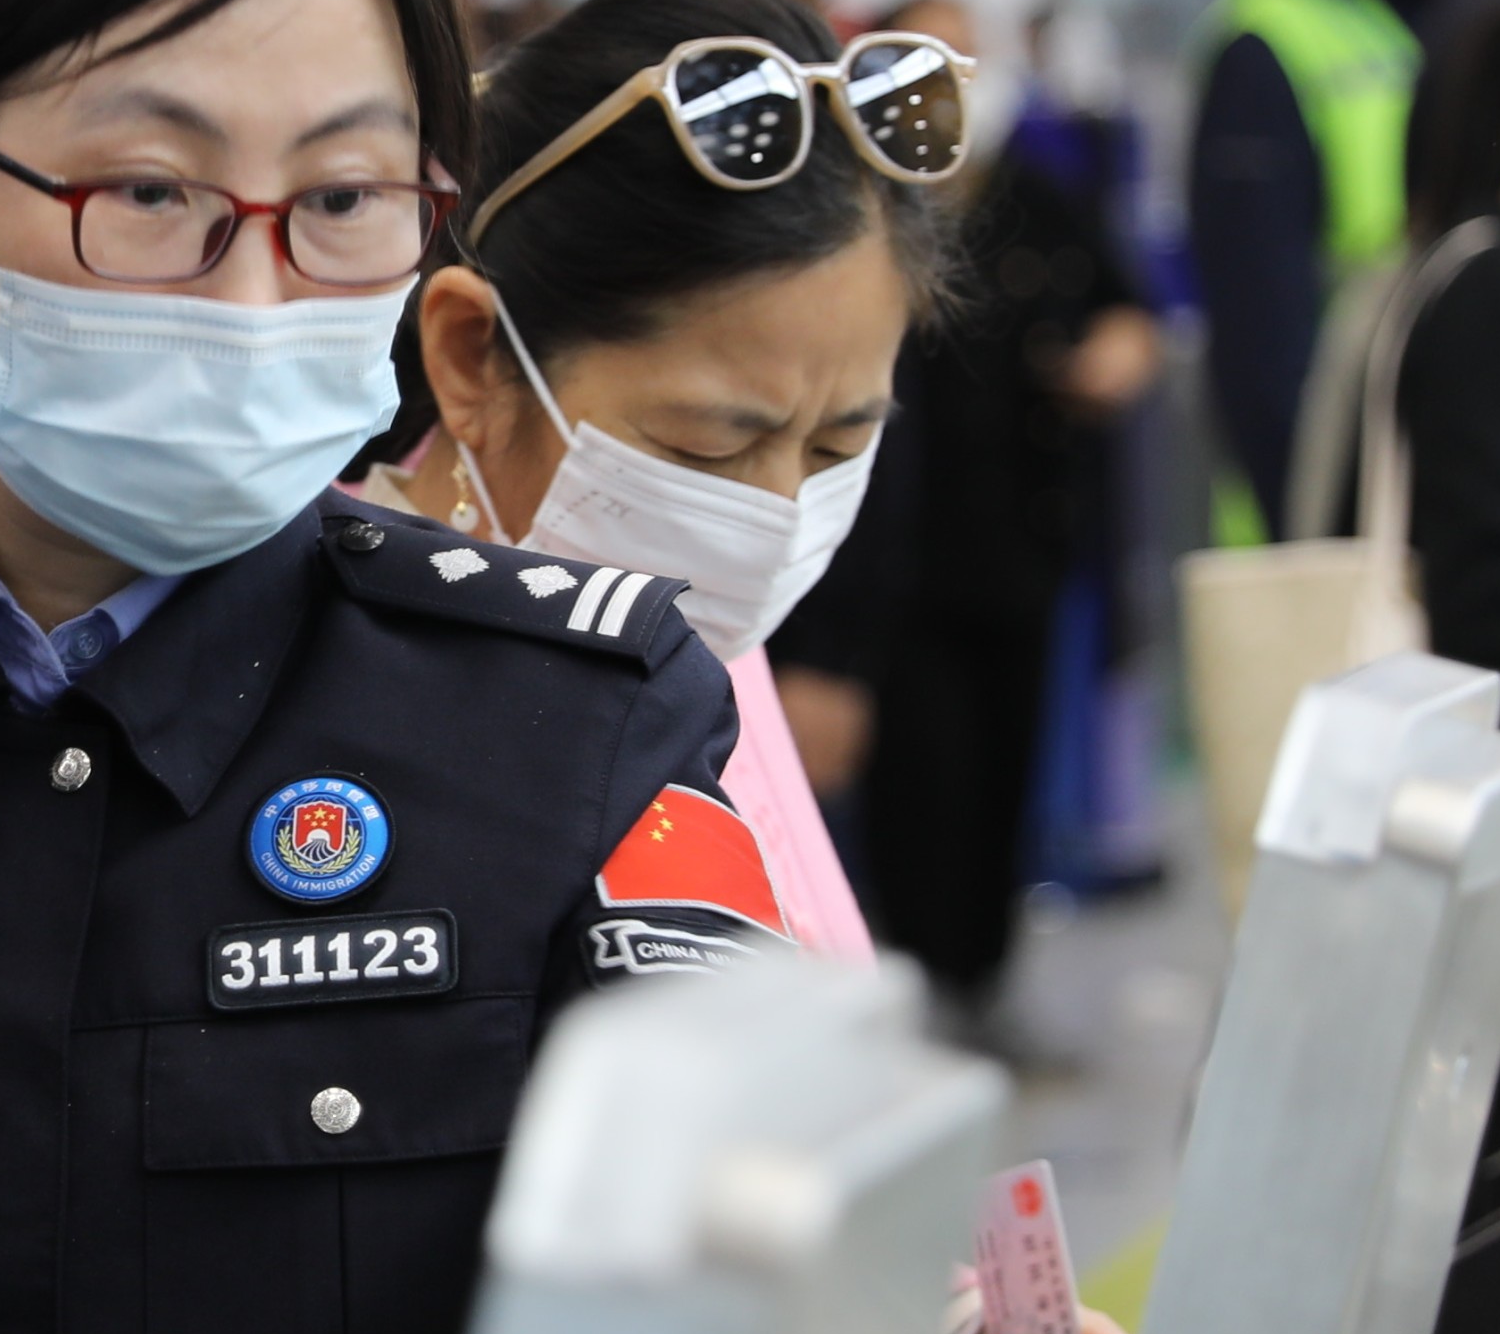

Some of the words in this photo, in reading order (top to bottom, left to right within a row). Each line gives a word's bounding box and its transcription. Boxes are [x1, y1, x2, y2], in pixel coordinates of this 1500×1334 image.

[261, 852, 289, 884] CHINA
[292, 854, 377, 891] IMMIGRATION
[220, 925, 440, 990] 311123
[636, 941, 702, 961] CHINA
